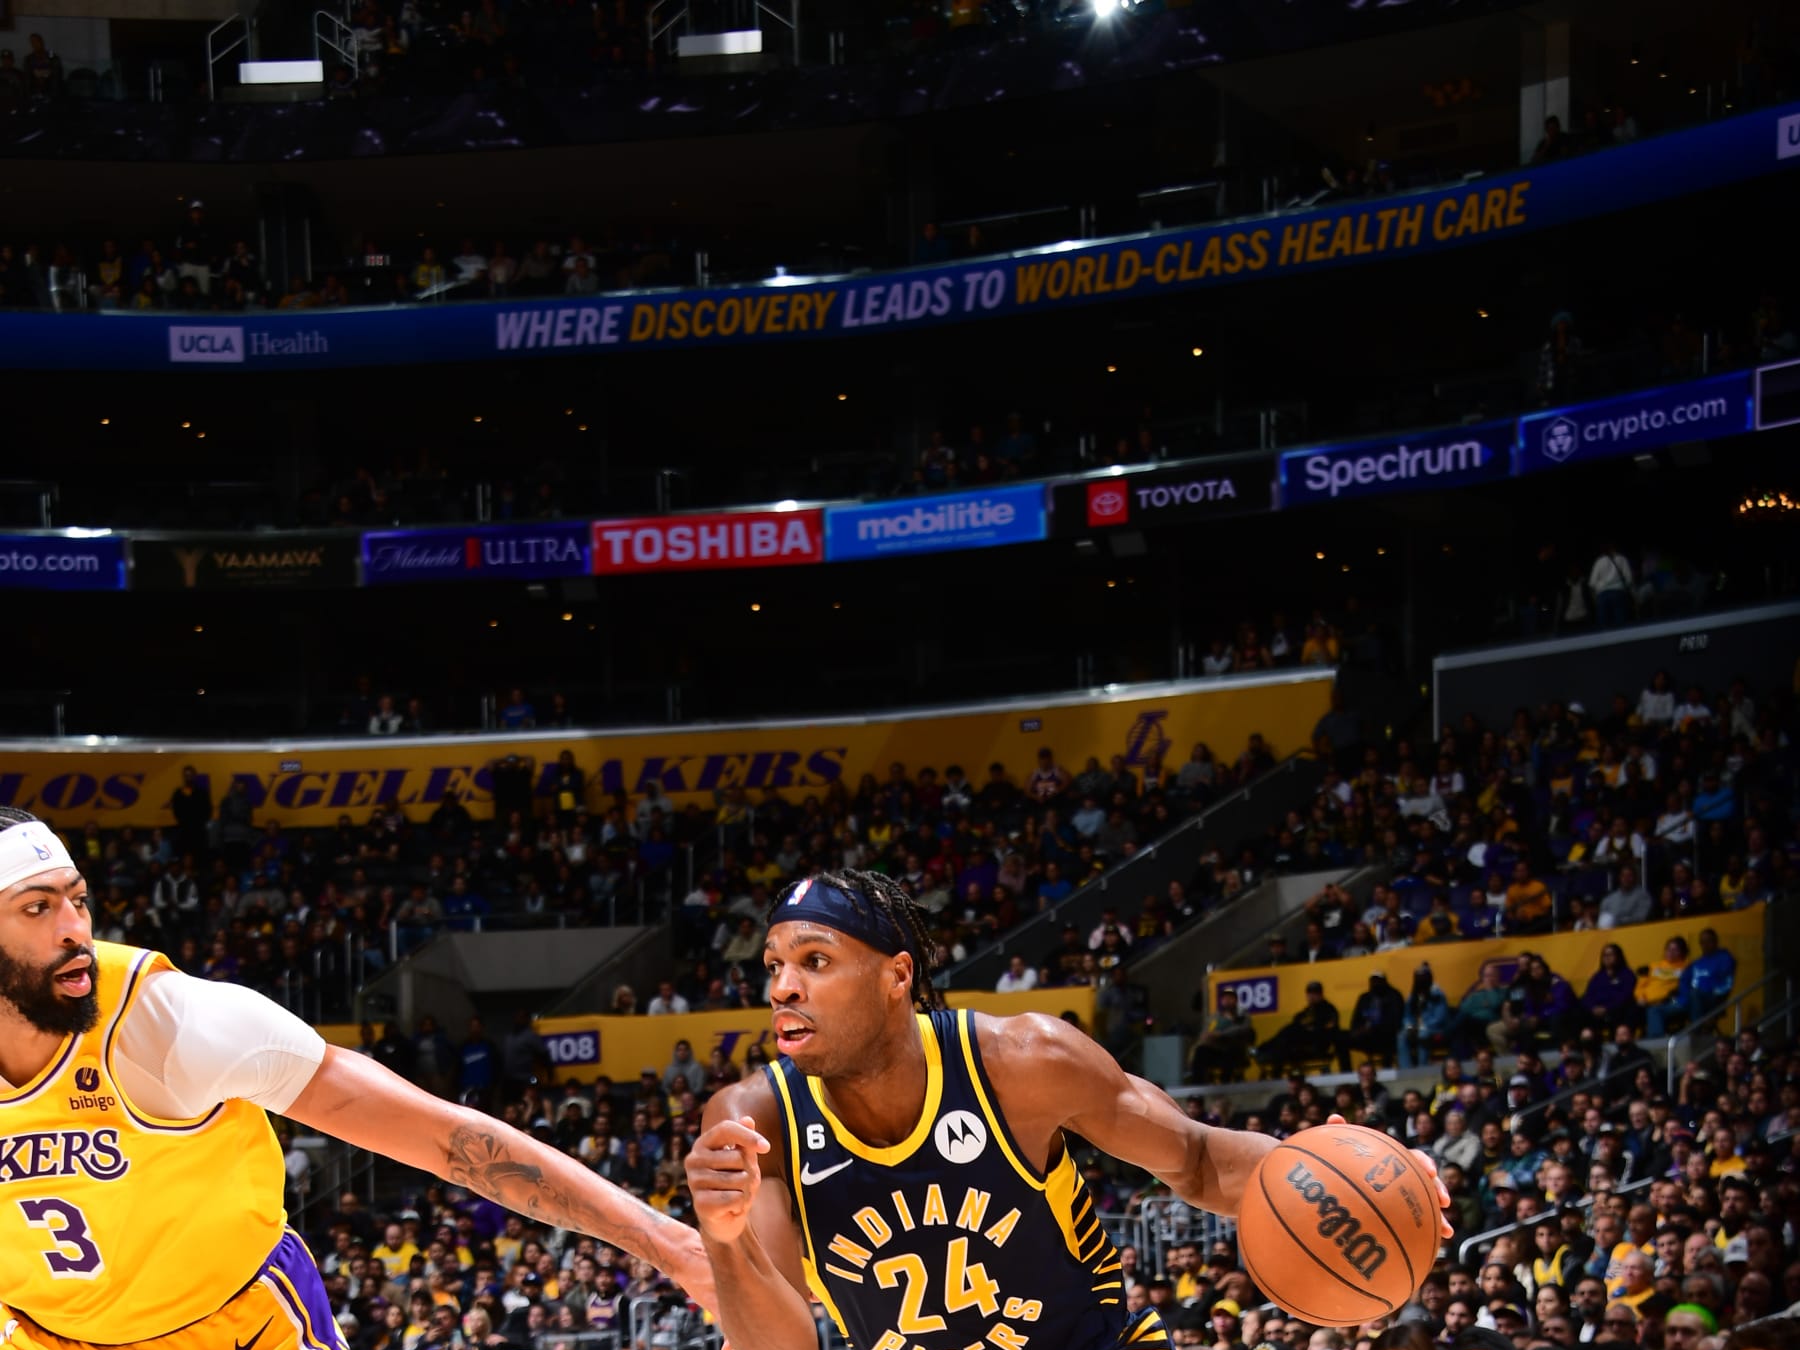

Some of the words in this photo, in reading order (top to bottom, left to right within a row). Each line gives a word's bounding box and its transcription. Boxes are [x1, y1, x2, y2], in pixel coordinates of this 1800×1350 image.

[495, 305, 624, 351] WHERE
[628, 290, 838, 343] DISCOVERY
[841, 275, 955, 329] LEADS
[963, 269, 1006, 312] TO
[1014, 228, 1270, 305] WORLD-CLASS
[1278, 202, 1425, 267] HEALTH
[1432, 180, 1532, 242] CARE
[179, 335, 236, 355] UCLA
[250, 330, 329, 356] Health
[1583, 397, 1728, 443] crypto.com
[1304, 438, 1484, 497] Spectrum
[1136, 478, 1237, 510] TOYOTA
[602, 518, 814, 565] TOSHIBA
[857, 498, 1017, 541] mobilitie
[483, 535, 583, 566] ULTRA
[1237, 980, 1273, 1010] 08
[546, 1034, 597, 1063] 108
[69, 1094, 116, 1111] bibigo
[806, 1123, 826, 1150] 6
[17, 1197, 106, 1280] 3
[825, 1183, 1022, 1284] INDIANA
[1287, 1162, 1388, 1281] Wilson
[873, 1236, 1001, 1335] 24
